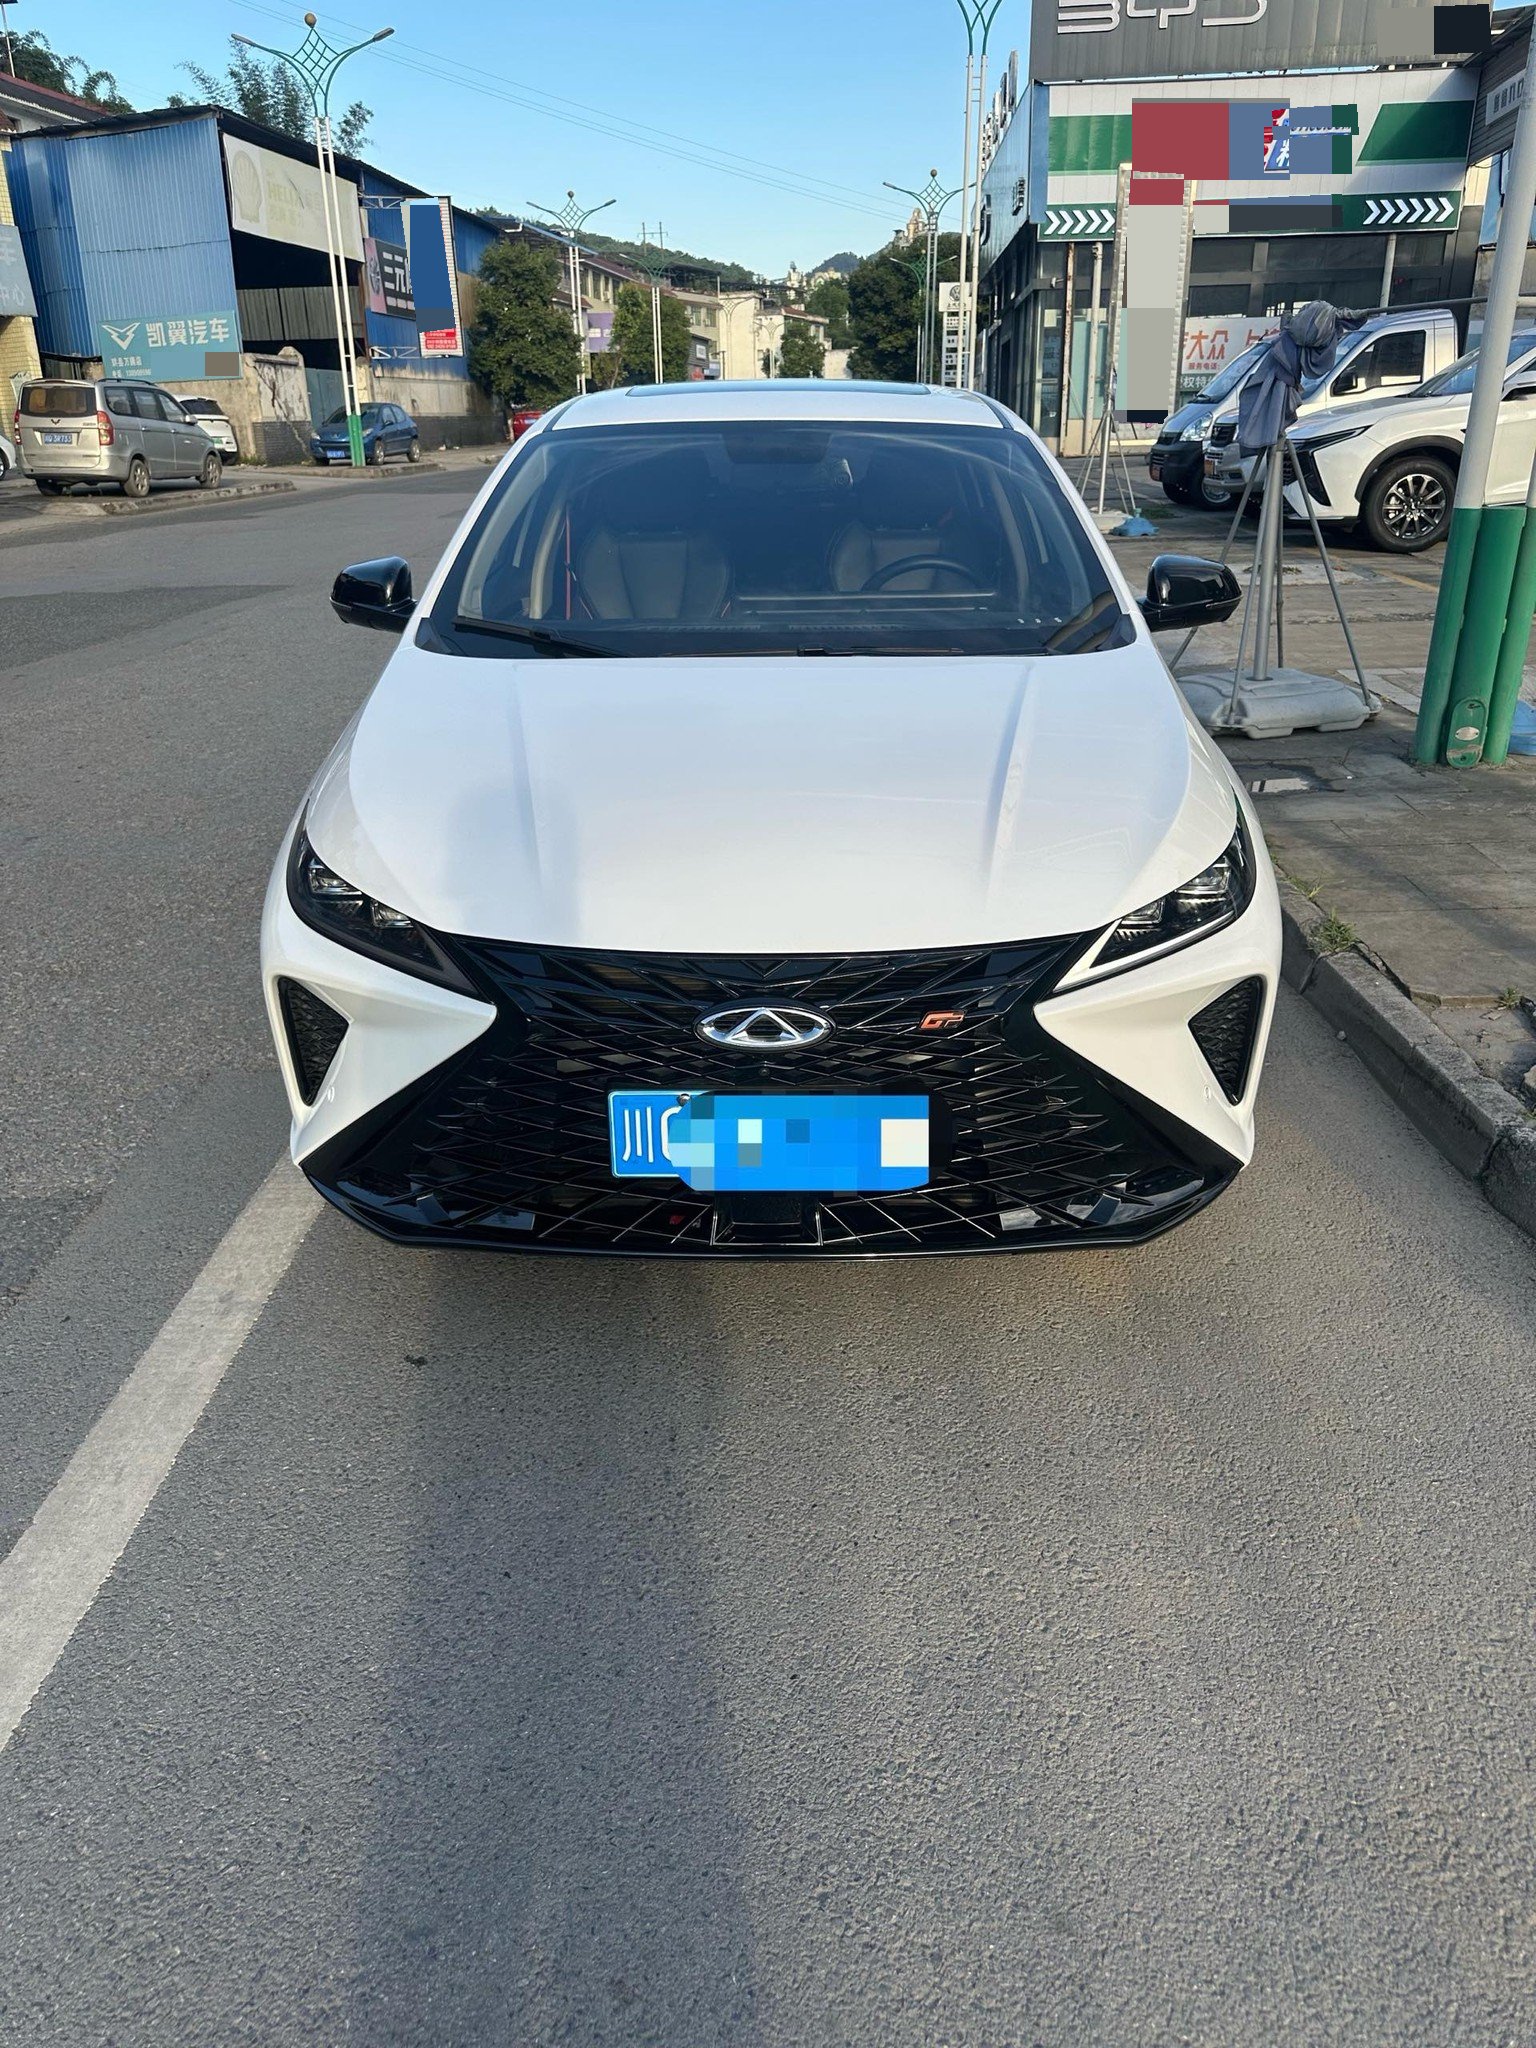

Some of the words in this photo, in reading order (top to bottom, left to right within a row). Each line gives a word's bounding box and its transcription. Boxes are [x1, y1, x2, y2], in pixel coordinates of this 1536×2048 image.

[382, 251, 412, 294] 三元
[145, 317, 230, 348] 凯翼汽车
[1183, 328, 1229, 360] 大众
[1181, 374, 1212, 389] 权特
[920, 1010, 965, 1031] GT
